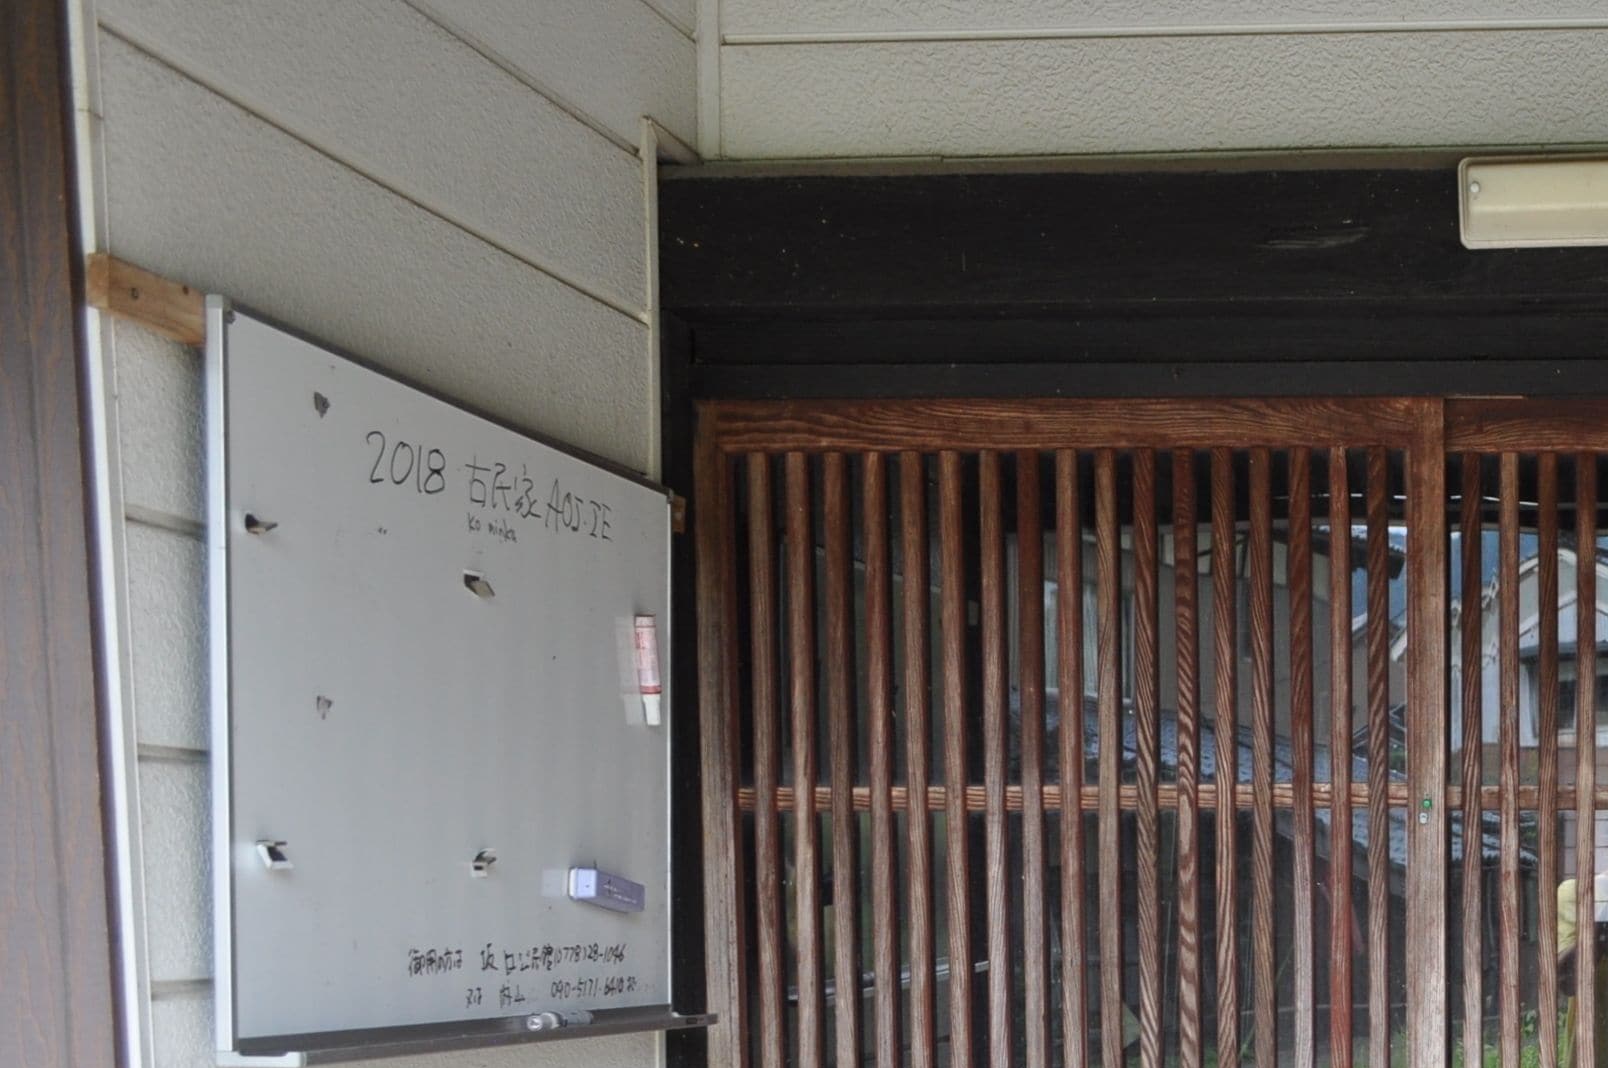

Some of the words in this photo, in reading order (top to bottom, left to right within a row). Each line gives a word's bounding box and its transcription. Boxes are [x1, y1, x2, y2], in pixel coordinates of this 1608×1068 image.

[366, 430, 446, 494] 2018
[465, 455, 541, 518] 古民家
